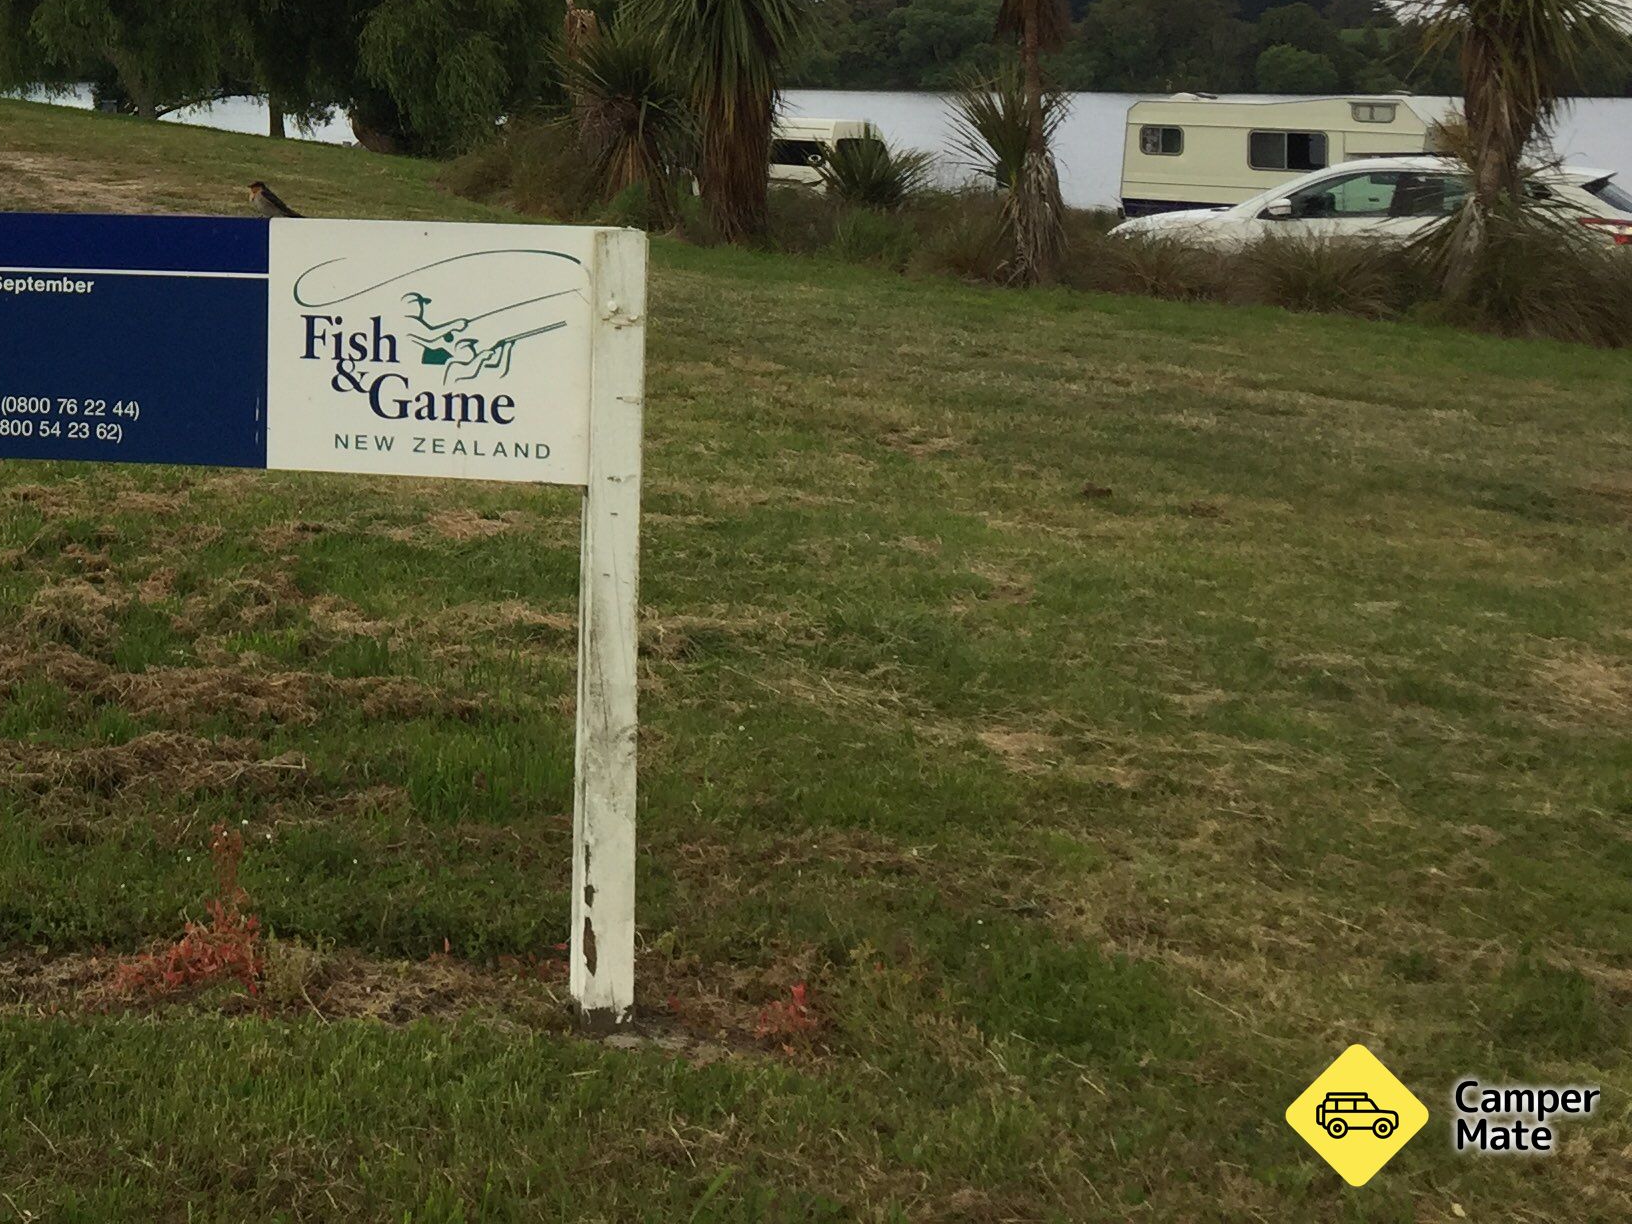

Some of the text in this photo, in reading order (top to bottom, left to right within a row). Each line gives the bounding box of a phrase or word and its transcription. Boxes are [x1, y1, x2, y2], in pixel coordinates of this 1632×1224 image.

[299, 314, 400, 363] Fish
[1, 396, 51, 416] (0800
[57, 398, 78, 415] 76
[84, 399, 106, 416] 22
[112, 400, 140, 420] 44)
[39, 421, 61, 438] 54
[68, 422, 90, 439] 23
[96, 423, 123, 443] 62)
[334, 433, 551, 460] NEW ZEALAND
